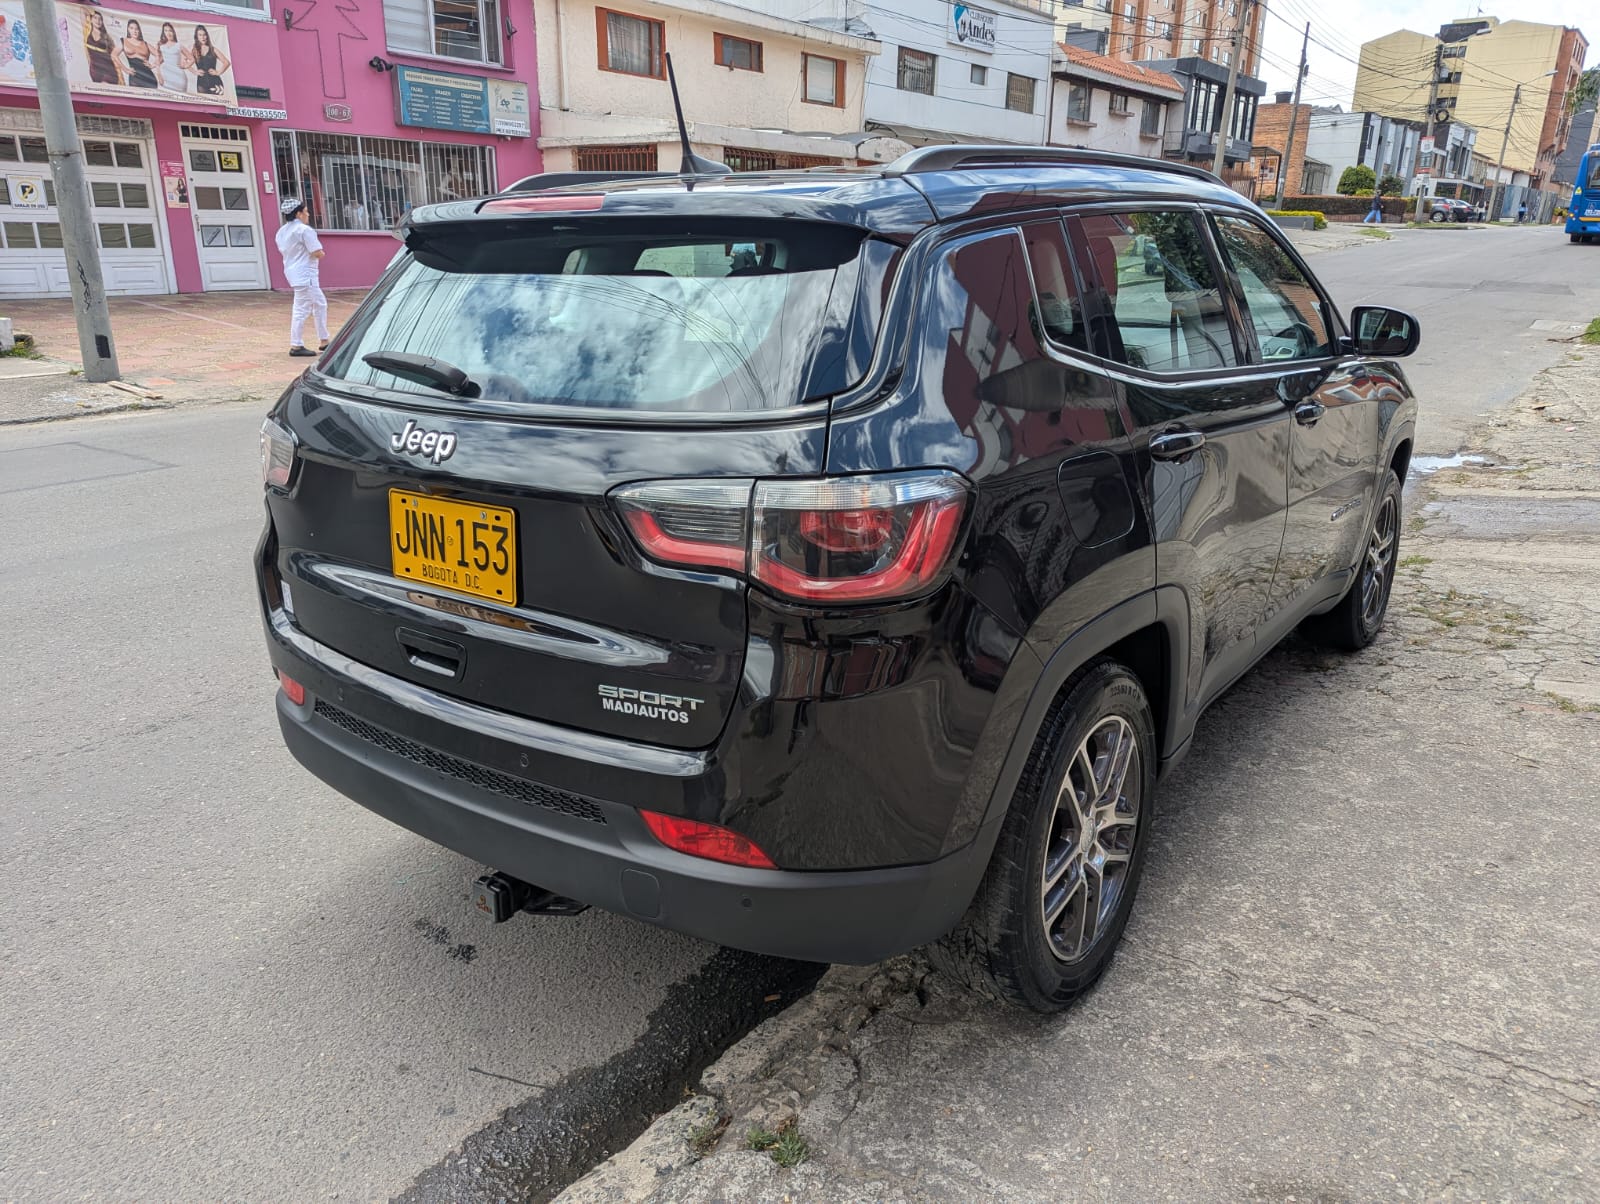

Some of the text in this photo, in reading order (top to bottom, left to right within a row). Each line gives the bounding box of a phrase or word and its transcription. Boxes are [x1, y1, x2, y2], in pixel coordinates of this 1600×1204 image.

[967, 20, 996, 43] Andes
[390, 419, 458, 465] Jeep
[396, 509, 509, 576] JNN 153
[422, 563, 484, 591] BOGOTA D.C.
[598, 684, 705, 711] SPORT
[602, 697, 689, 724] MADIAUTOS
